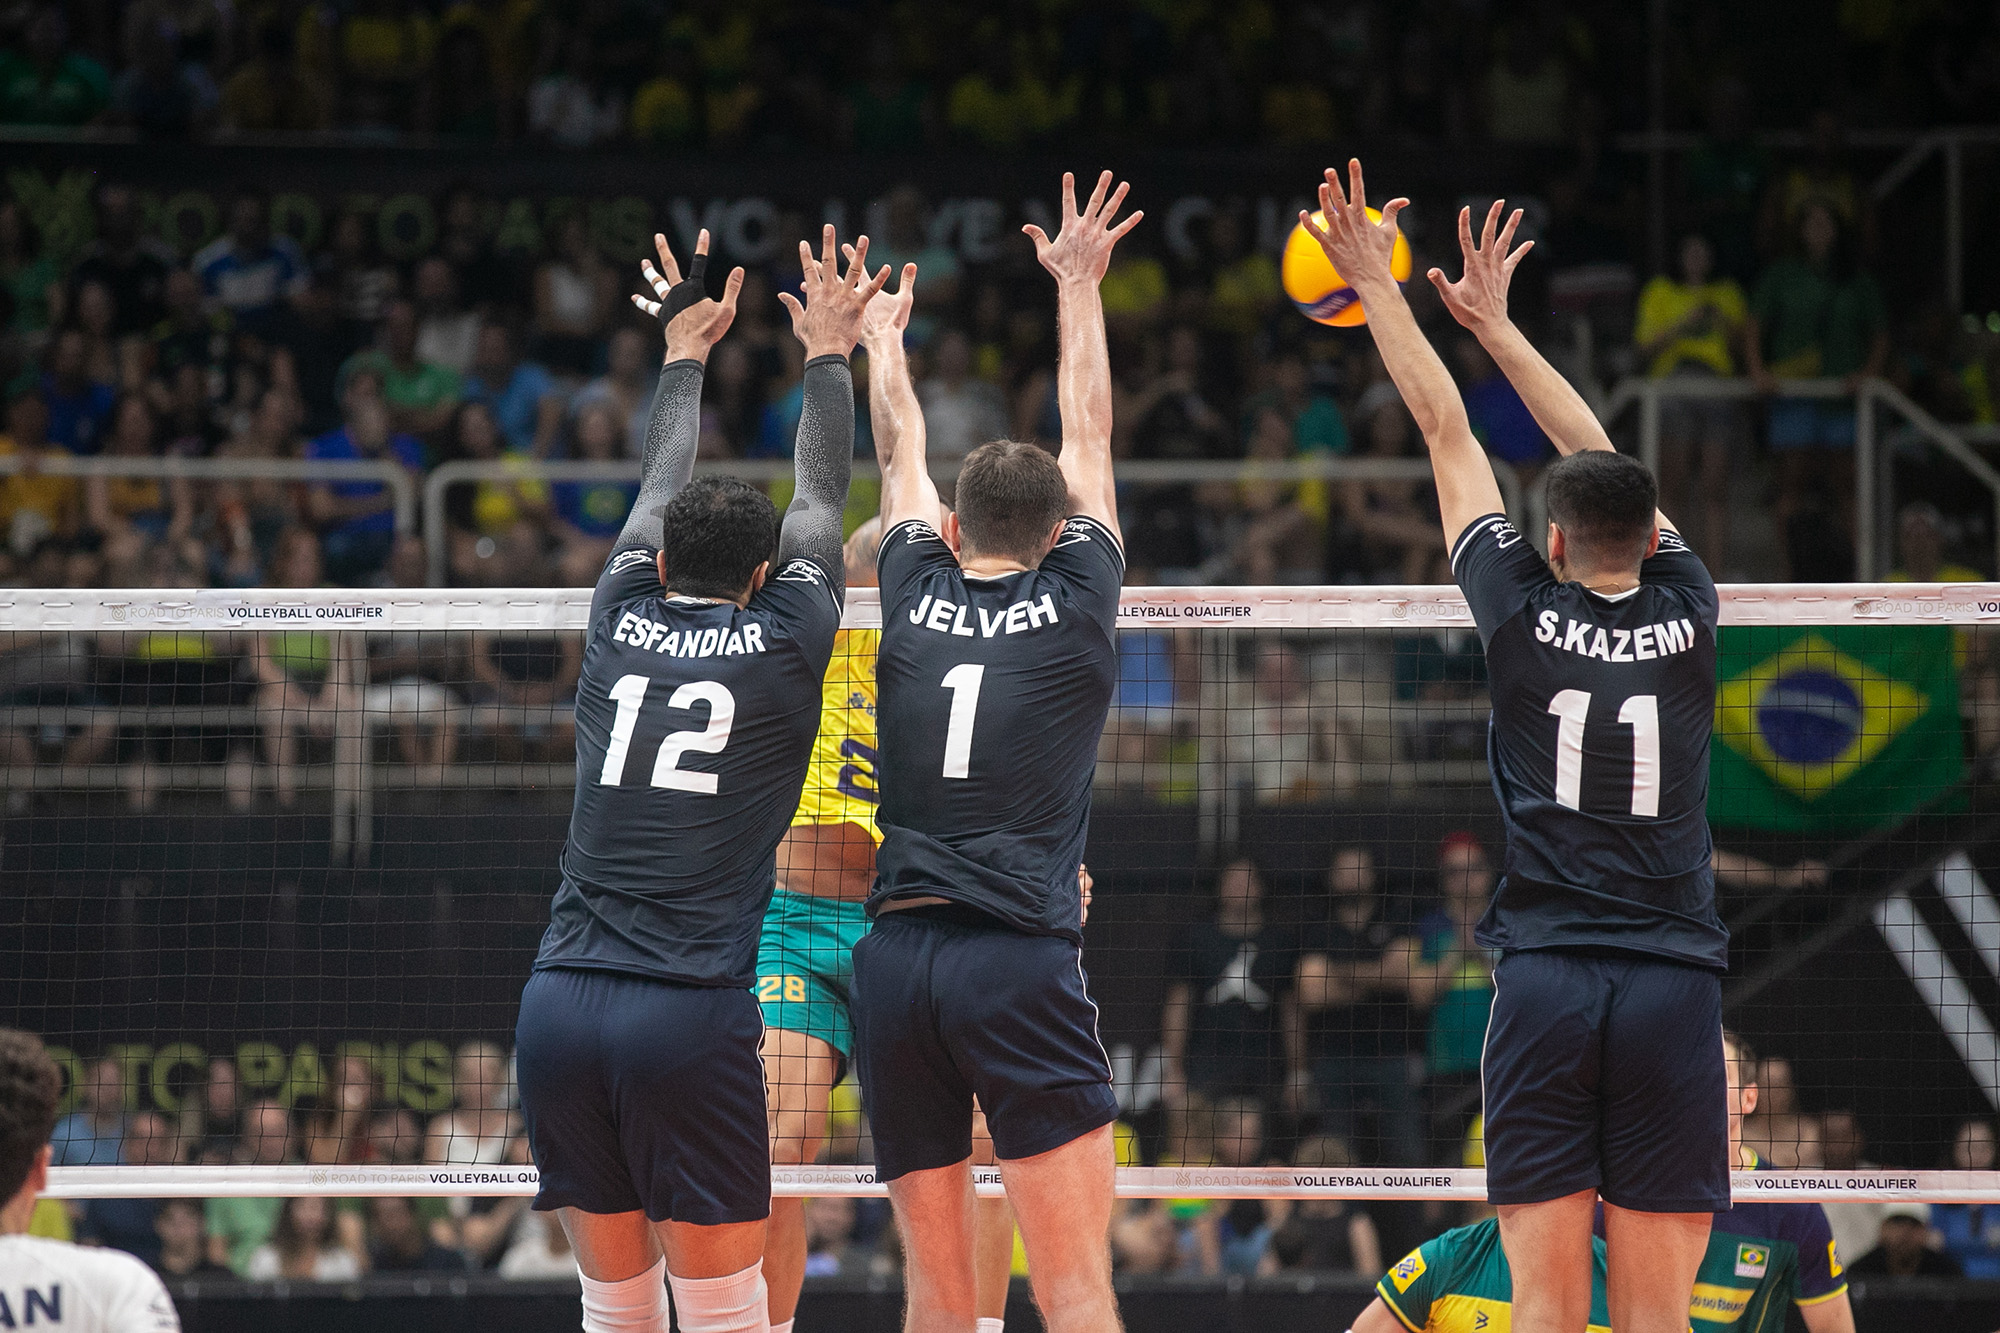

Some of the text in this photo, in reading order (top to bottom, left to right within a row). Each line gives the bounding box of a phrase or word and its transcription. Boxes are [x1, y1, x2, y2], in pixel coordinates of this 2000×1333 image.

[130, 607, 383, 619] ROAD TO PARIS VOLLEYBALL QUALIFIER
[1184, 606, 1251, 618] QUALIFIER
[1410, 604, 1467, 616] ROAD TO
[1875, 601, 2000, 613] ROAD TO PARIS VO
[909, 593, 1060, 639] JELVEH
[612, 611, 766, 659] ESFANDIAR
[1535, 609, 1695, 663] S.KAZEMI
[940, 663, 985, 778] 1
[600, 674, 735, 794] 12
[1547, 689, 1660, 817] 11
[758, 974, 806, 1002] 28
[330, 1173, 540, 1184] ROAD TO PARIS VOLLEYBALL QU
[796, 1174, 813, 1184] TO
[816, 1174, 852, 1184] PARIS
[1194, 1176, 1452, 1188] ROAD TO PARIS VOLLEYBALL QUALIFIER
[1755, 1178, 1843, 1189] VOLLEYBALL
[1846, 1178, 1917, 1190] QUALIFIER
